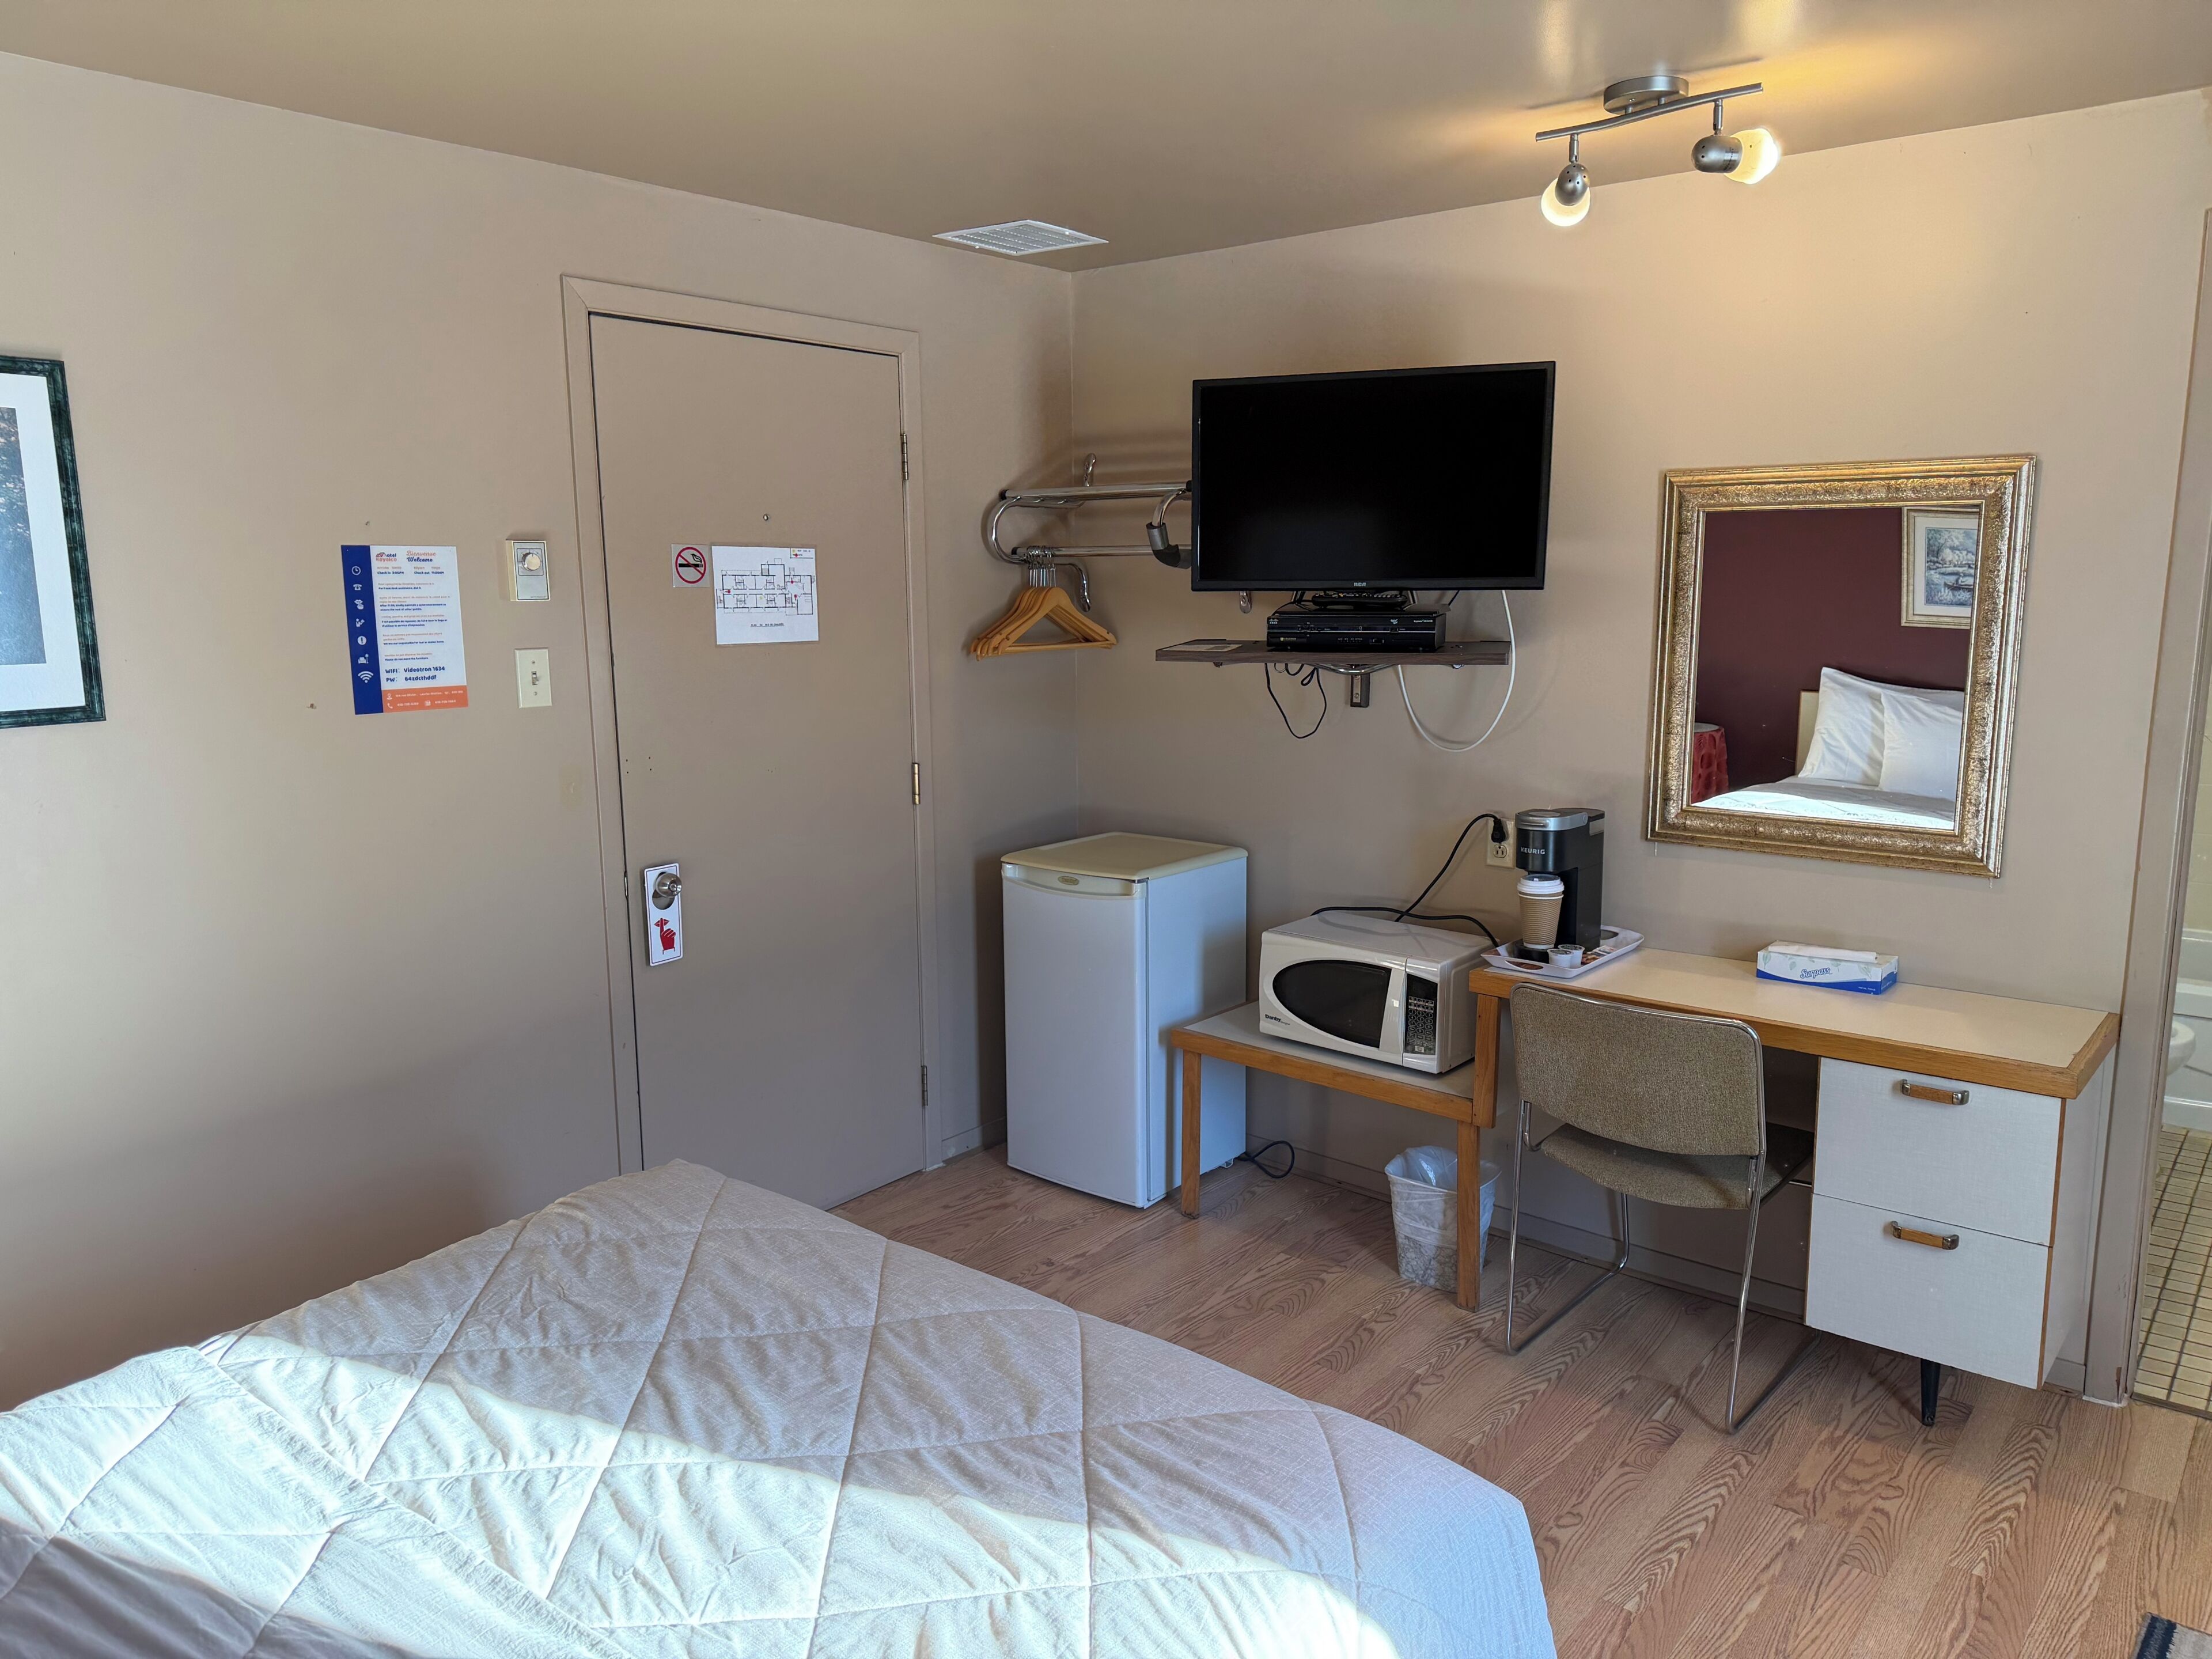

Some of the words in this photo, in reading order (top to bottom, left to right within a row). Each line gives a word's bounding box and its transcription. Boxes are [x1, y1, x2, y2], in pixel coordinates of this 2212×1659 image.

[1520, 847, 1545, 855] KEURIG
[1800, 968, 1831, 979] Surpass
[1265, 1014, 1281, 1022] Danby
